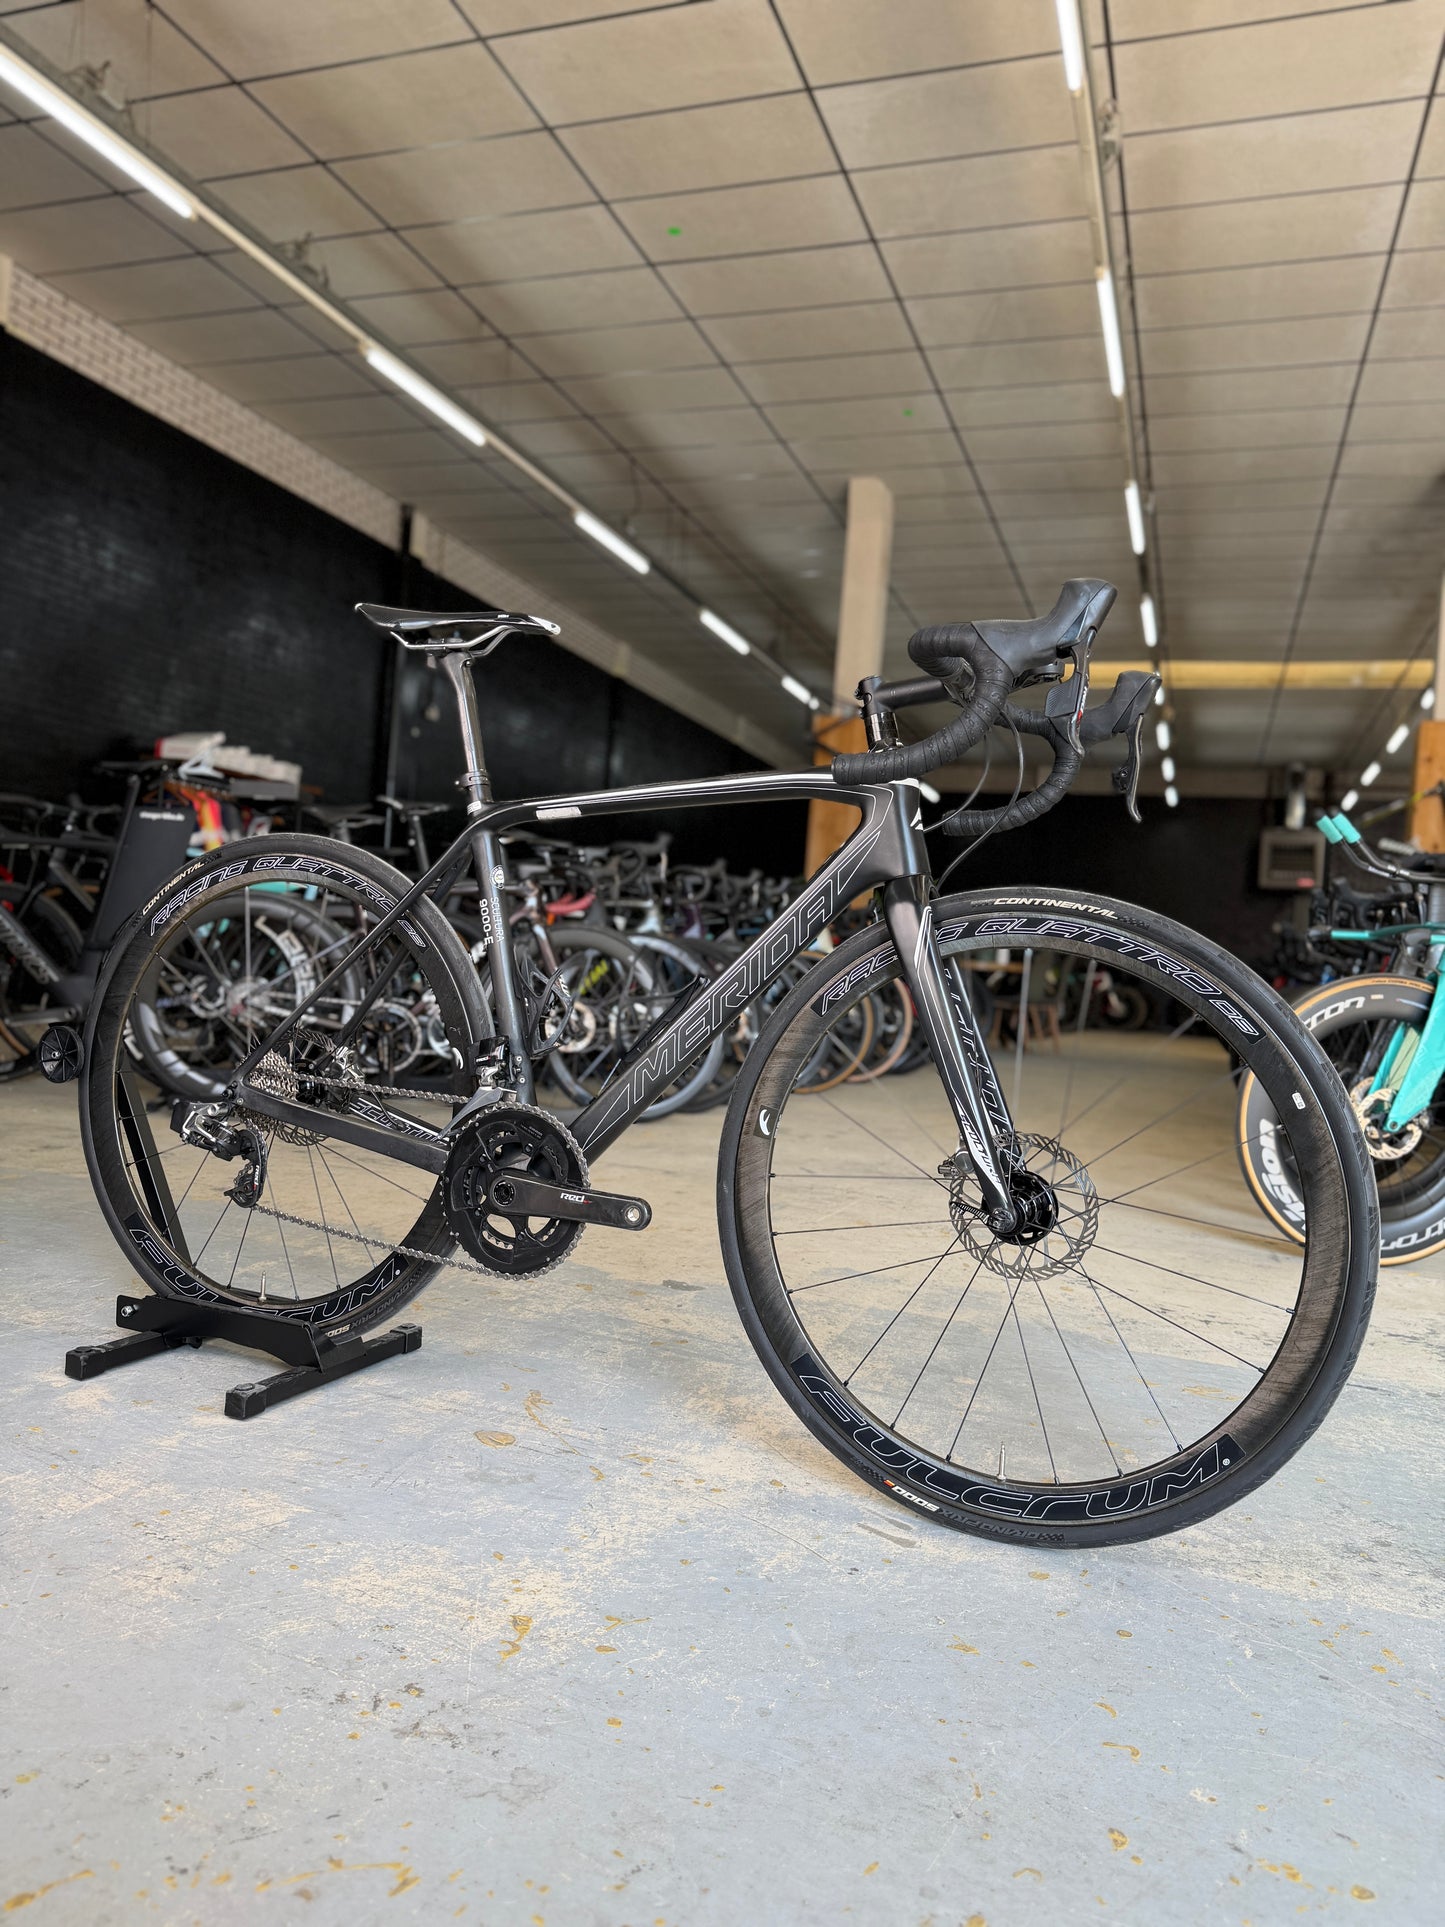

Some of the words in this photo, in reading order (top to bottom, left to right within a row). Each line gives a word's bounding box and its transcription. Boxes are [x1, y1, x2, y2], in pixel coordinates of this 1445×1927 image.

[142, 861, 205, 916] CONTINENTAL
[150, 860, 248, 937] RACING
[994, 897, 1119, 920] CONTINENTAL
[479, 898, 494, 946] 9000-E
[490, 896, 506, 942] SCULTURA
[975, 918, 1222, 995] QUATTRO
[633, 878, 834, 1105] MERIDA
[325, 1324, 350, 1338] 500
[799, 1374, 1220, 1520] FULCRUM
[892, 1485, 940, 1513] 5000
